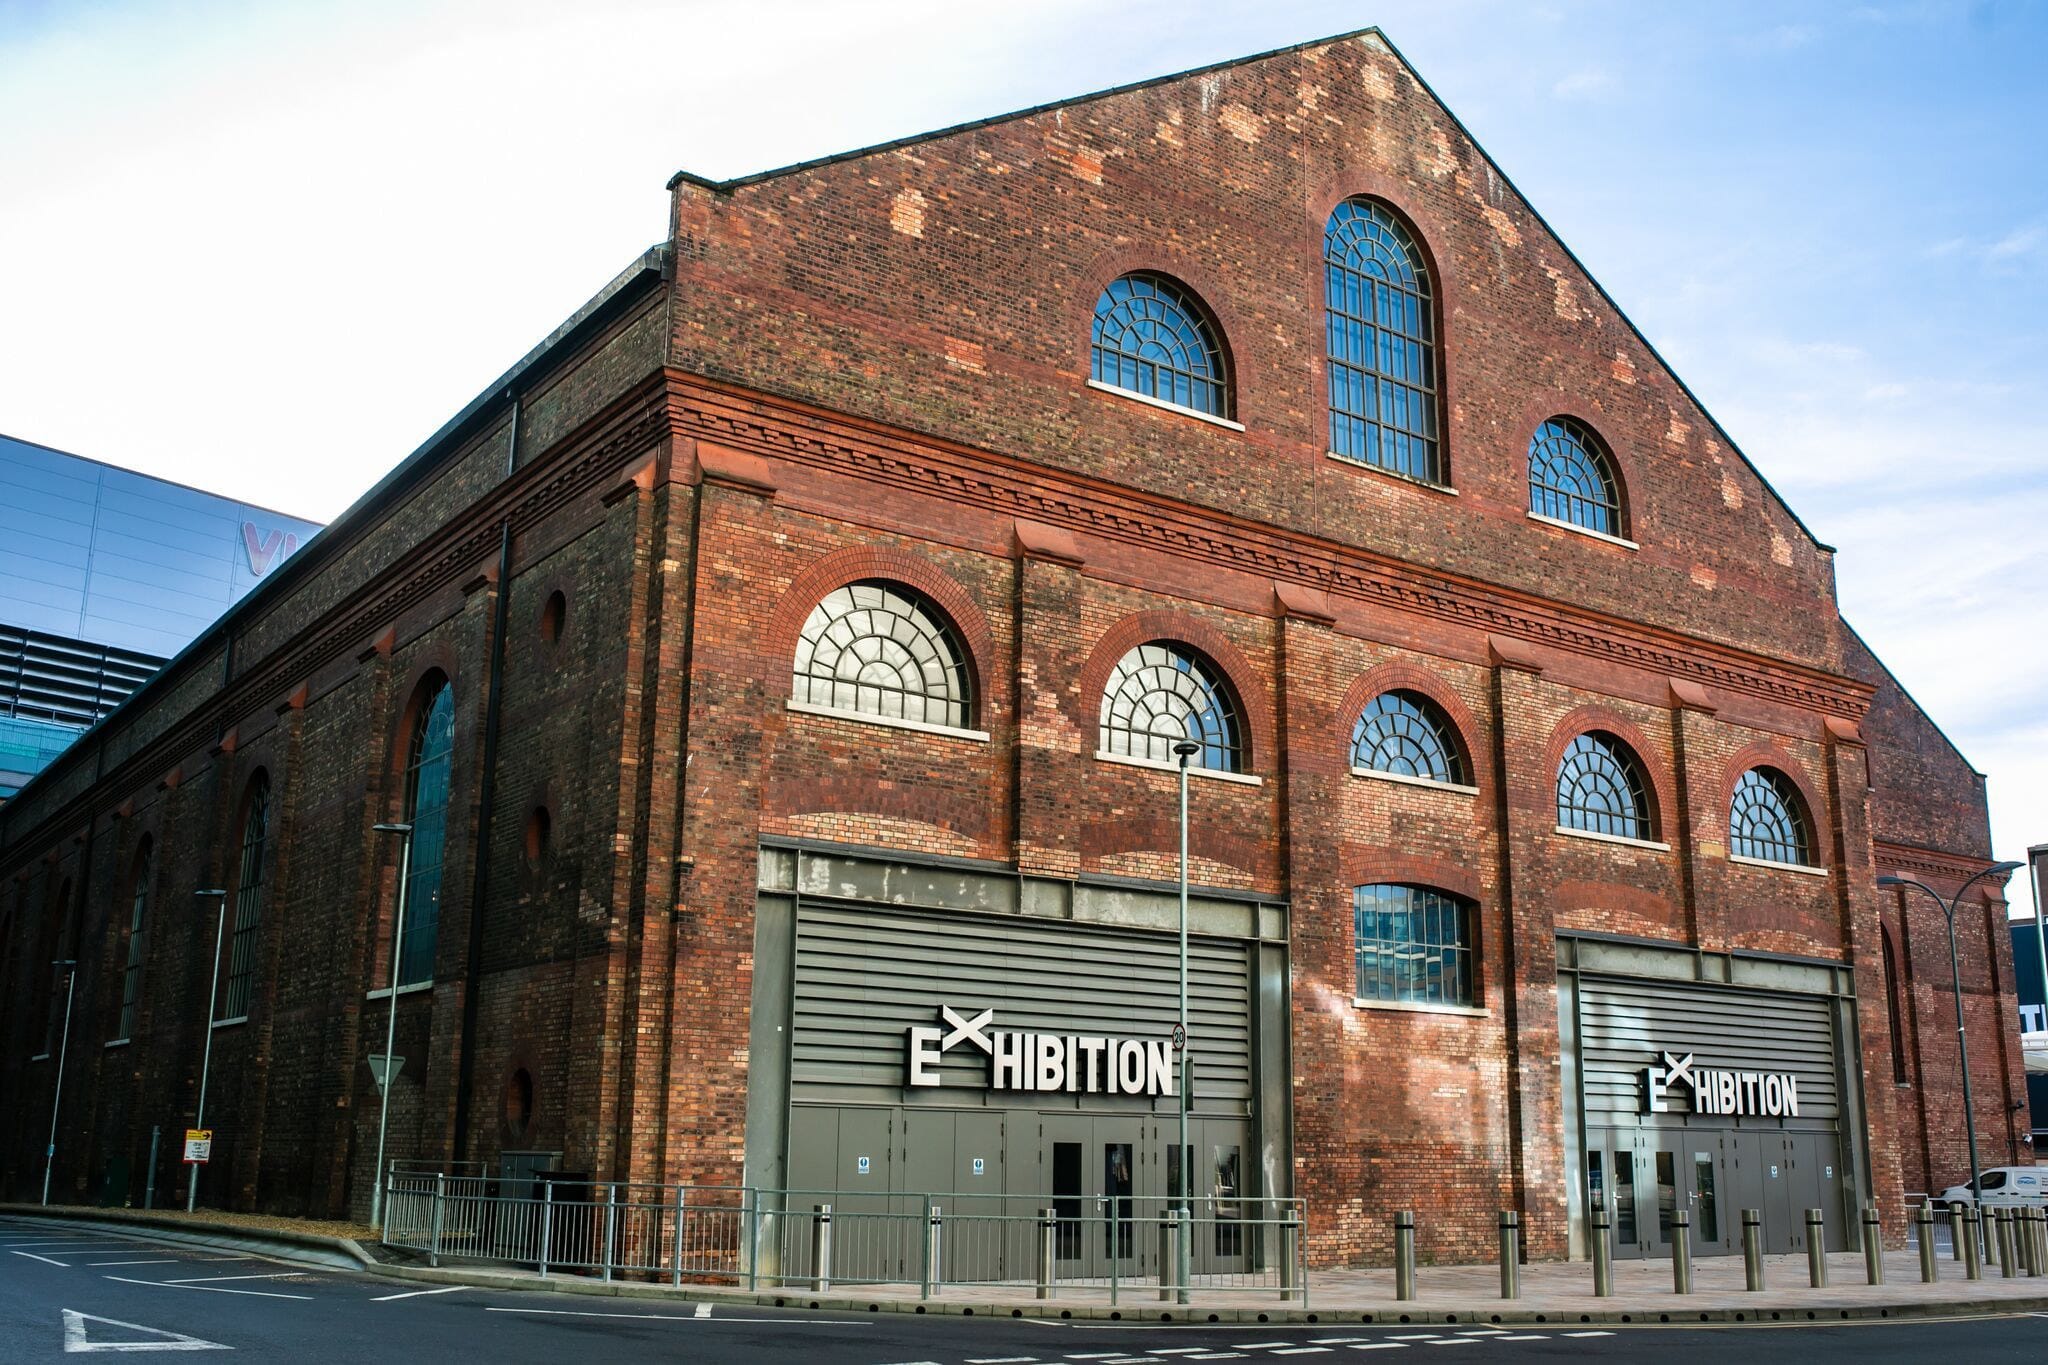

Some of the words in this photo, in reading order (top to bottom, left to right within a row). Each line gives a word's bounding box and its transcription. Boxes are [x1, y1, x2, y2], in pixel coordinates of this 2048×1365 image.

[909, 1004, 1173, 1095] EXHIBITION
[1174, 1031, 1184, 1043] 20
[1647, 1050, 1799, 1116] EXHIBITION
